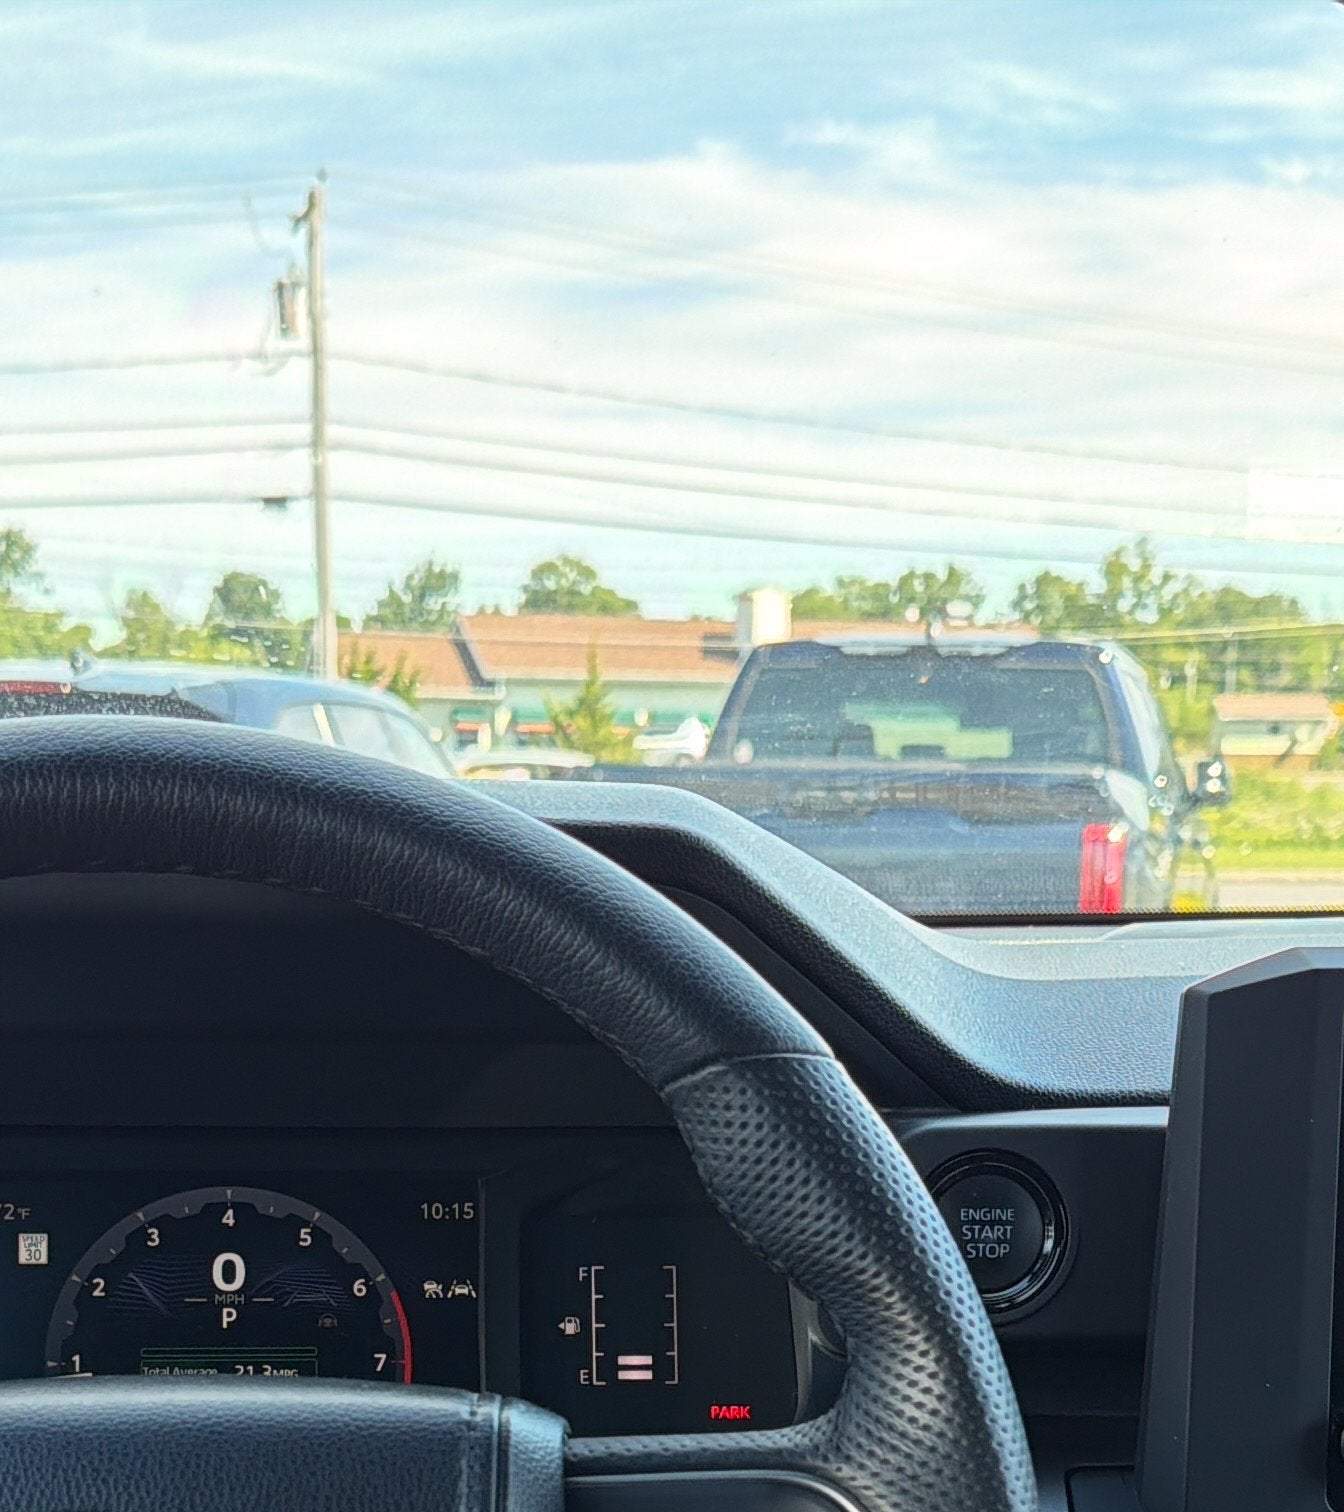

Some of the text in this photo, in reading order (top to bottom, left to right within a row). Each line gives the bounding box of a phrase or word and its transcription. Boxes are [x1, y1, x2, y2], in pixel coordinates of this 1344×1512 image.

[221, 1208, 236, 1228] 4
[420, 1202, 475, 1221] 10:15
[959, 1207, 1016, 1222] ENGINE
[146, 1227, 161, 1247] 3
[298, 1227, 313, 1247] 5
[961, 1224, 1014, 1241] START
[24, 1248, 42, 1262] 30
[965, 1242, 1011, 1259] STOP
[211, 1251, 247, 1293] 0
[578, 1266, 589, 1282] F
[91, 1277, 106, 1298] 2
[352, 1277, 368, 1298] 6
[214, 1293, 245, 1306] MPH
[221, 1307, 238, 1329] P
[71, 1353, 81, 1373] 1
[373, 1352, 388, 1373] 7
[579, 1369, 590, 1385] E
[709, 1405, 752, 1421] PARK
